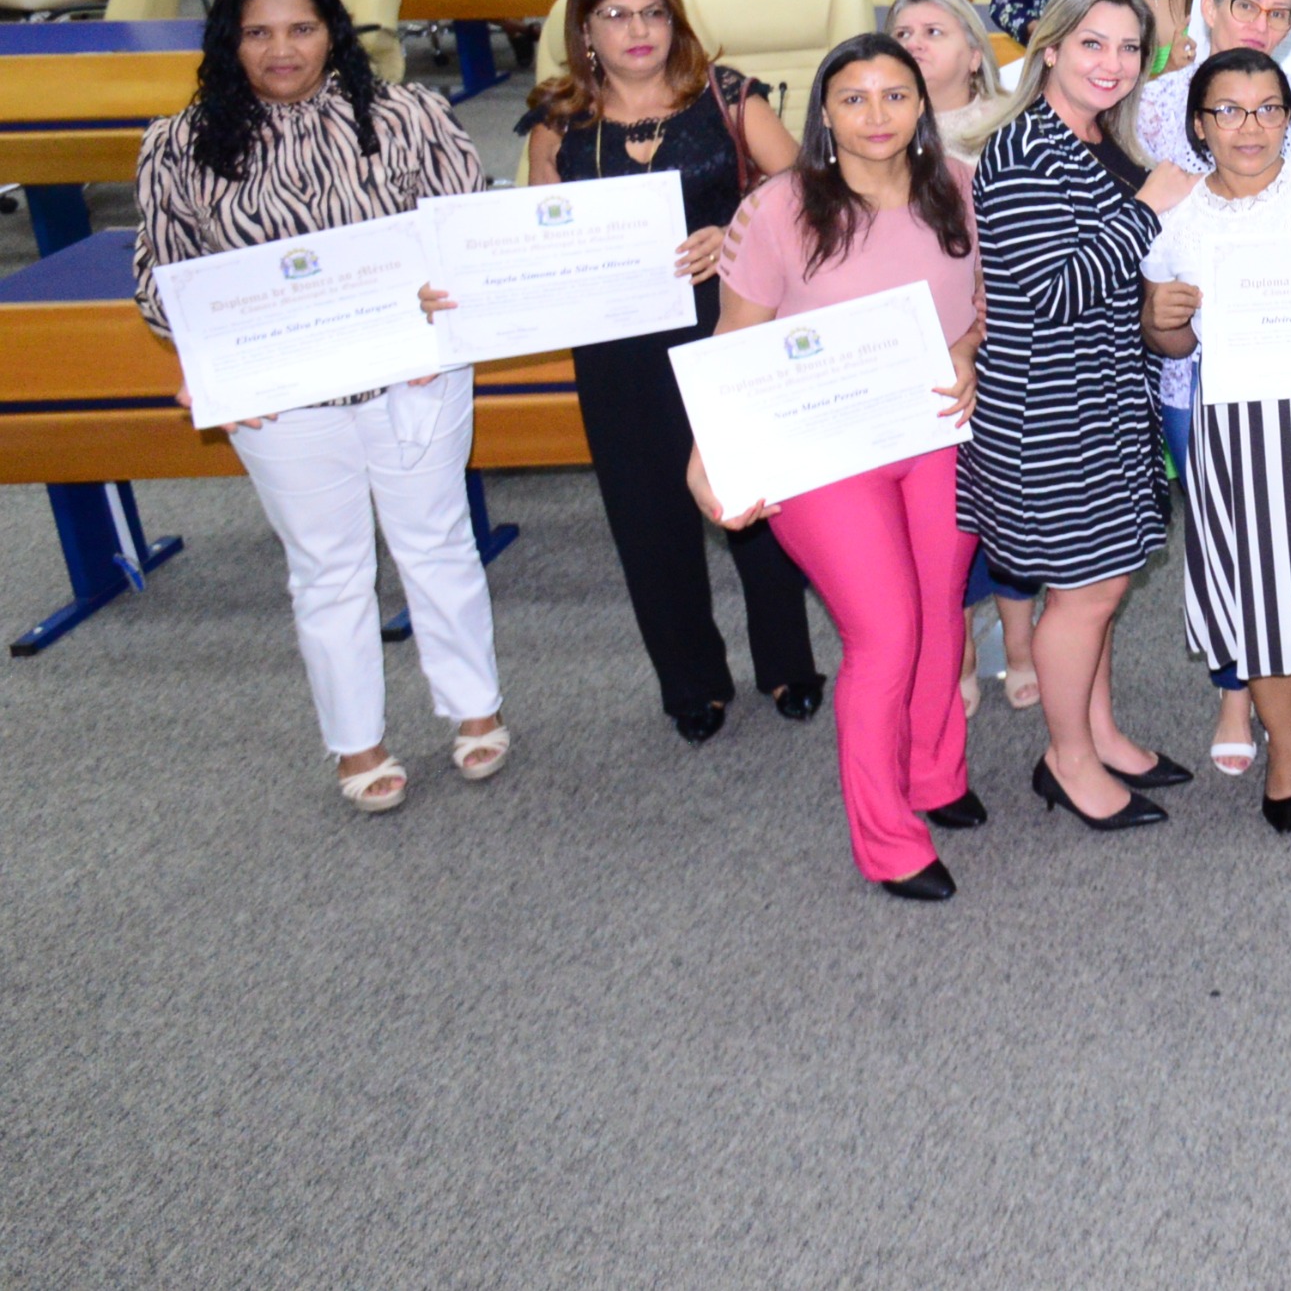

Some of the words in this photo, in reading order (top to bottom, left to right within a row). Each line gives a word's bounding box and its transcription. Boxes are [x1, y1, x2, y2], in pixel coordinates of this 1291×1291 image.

[466, 235, 520, 251] Diploma
[524, 233, 536, 243] de
[543, 228, 584, 241] Honra
[587, 225, 602, 235] ao
[606, 218, 648, 234] Mérito
[520, 269, 556, 281] Simone
[560, 267, 572, 276] da
[575, 263, 599, 274] Silva
[602, 257, 641, 271] Oliveira
[1240, 276, 1290, 289] Diploma
[210, 293, 268, 314] Diploma
[272, 287, 286, 299] de
[290, 278, 334, 294] Honra
[338, 272, 352, 283] ao
[357, 259, 401, 279] Mérito
[236, 328, 267, 346] Elvira
[270, 327, 283, 337] da
[286, 318, 312, 334] Silva
[314, 310, 352, 328] Pereira
[354, 299, 398, 317] Marques
[719, 374, 774, 397] Diploma
[777, 368, 790, 378] de
[795, 355, 836, 373] Honra
[840, 351, 854, 361] ao
[857, 337, 899, 358] Mérito
[774, 408, 798, 420] Nora
[801, 399, 831, 413] Maria
[833, 387, 869, 404] Pereira
